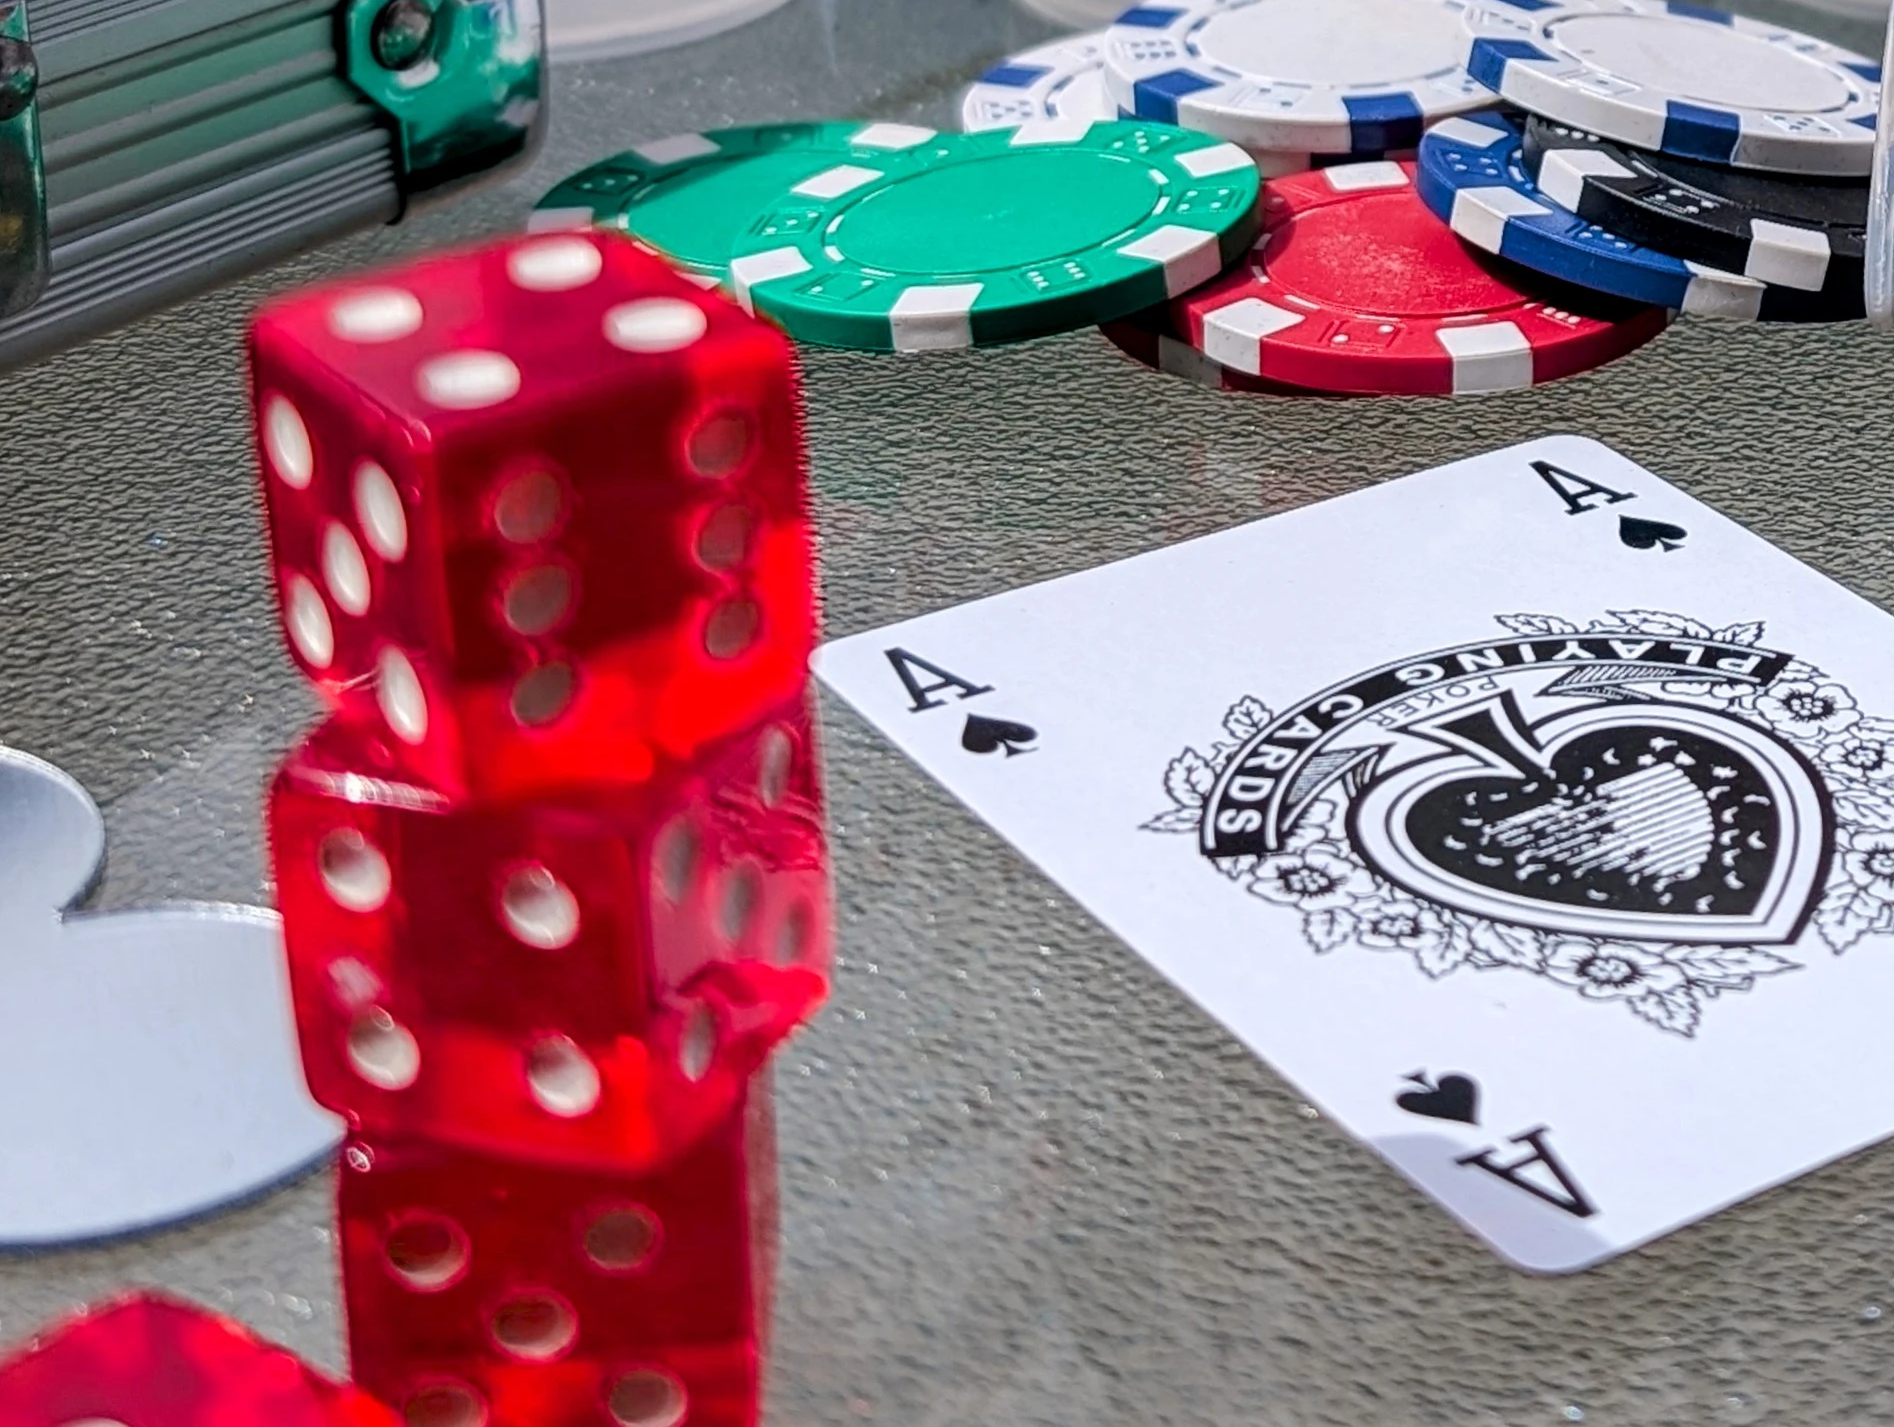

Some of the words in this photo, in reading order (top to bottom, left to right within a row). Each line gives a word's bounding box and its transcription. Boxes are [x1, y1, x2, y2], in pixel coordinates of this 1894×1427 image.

[1530, 459, 1641, 519] A
[880, 646, 995, 713] A
[1392, 638, 1764, 684] PLAYING
[1361, 674, 1503, 730] POKER
[1215, 692, 1366, 837] CARDS
[1456, 1127, 1604, 1221] A
